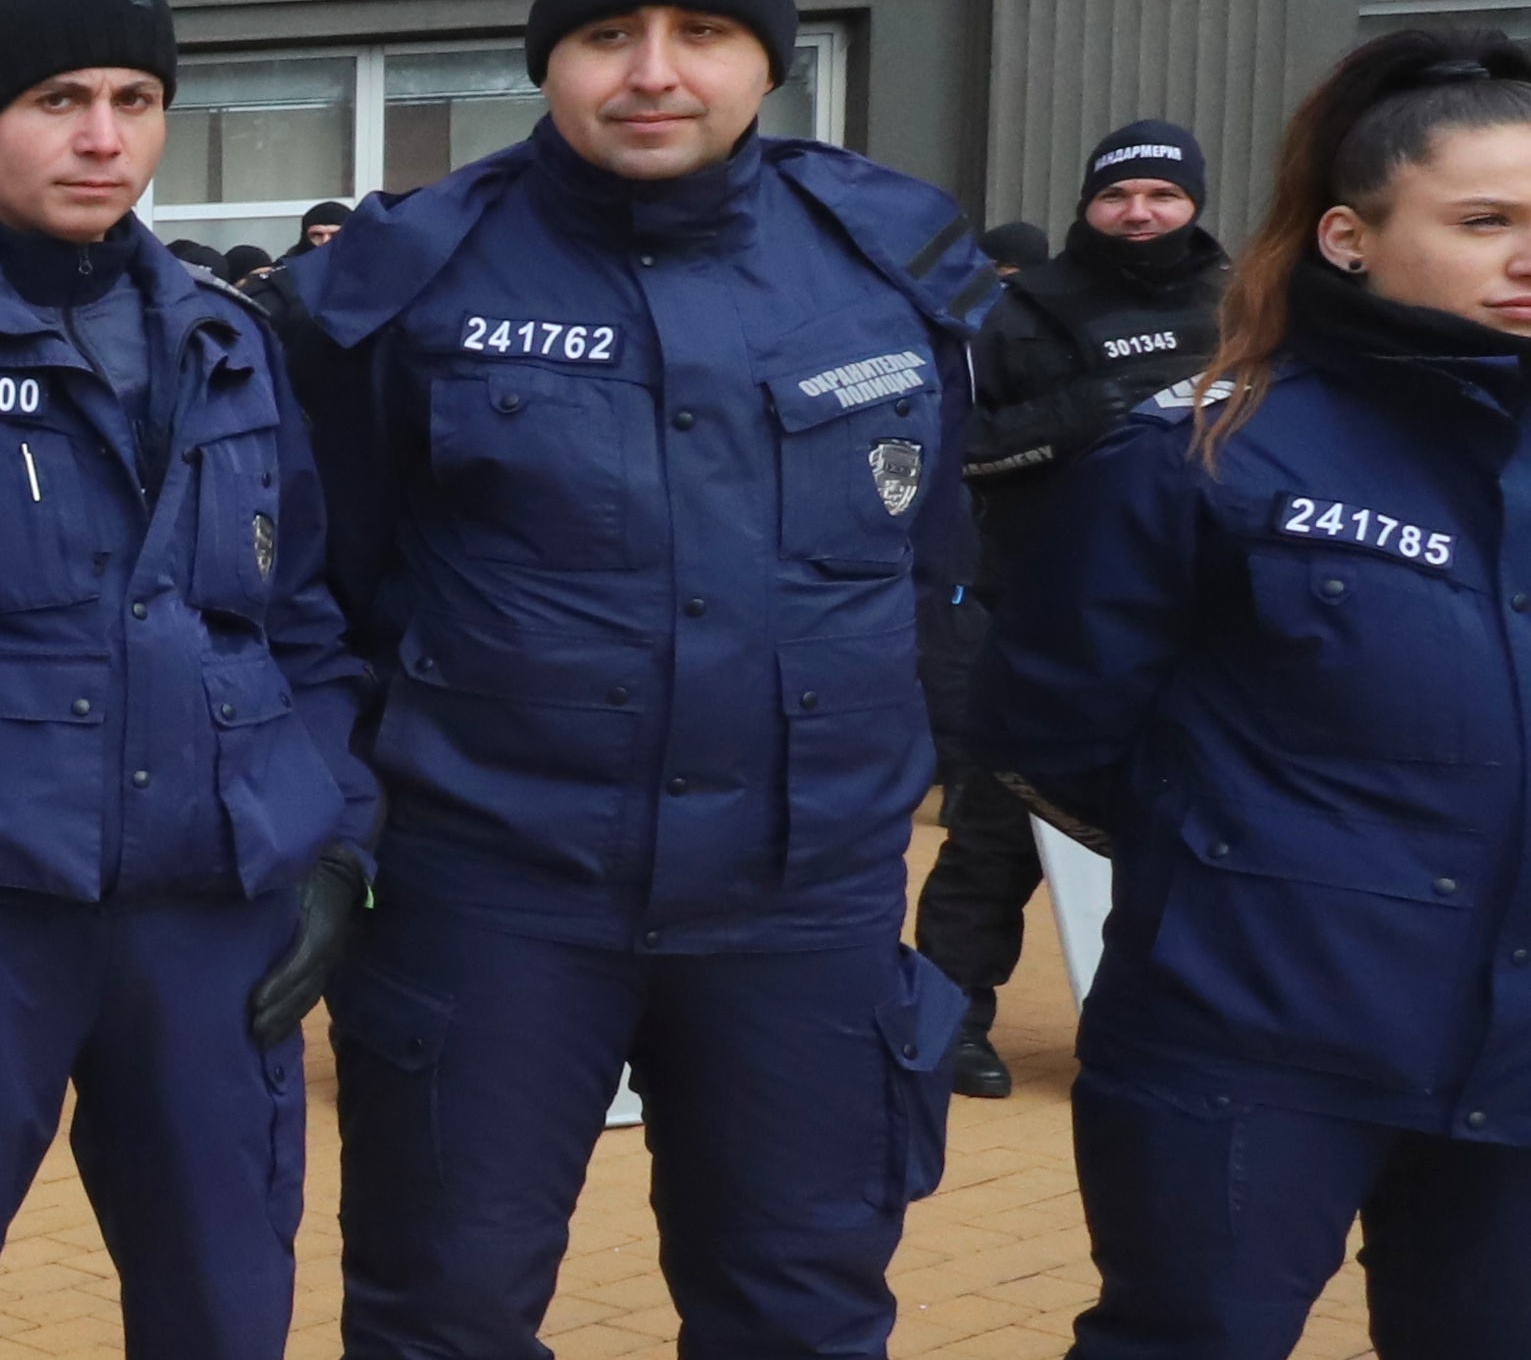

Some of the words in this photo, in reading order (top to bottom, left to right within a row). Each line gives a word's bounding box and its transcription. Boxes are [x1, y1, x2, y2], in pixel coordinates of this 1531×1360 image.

[464, 317, 614, 359] 241762
[1103, 331, 1177, 358] 301345
[798, 351, 927, 397] ОХРАНИТЕЛНА
[834, 368, 924, 409] ПОЛИЦИЯ
[1285, 498, 1451, 565] 241785
